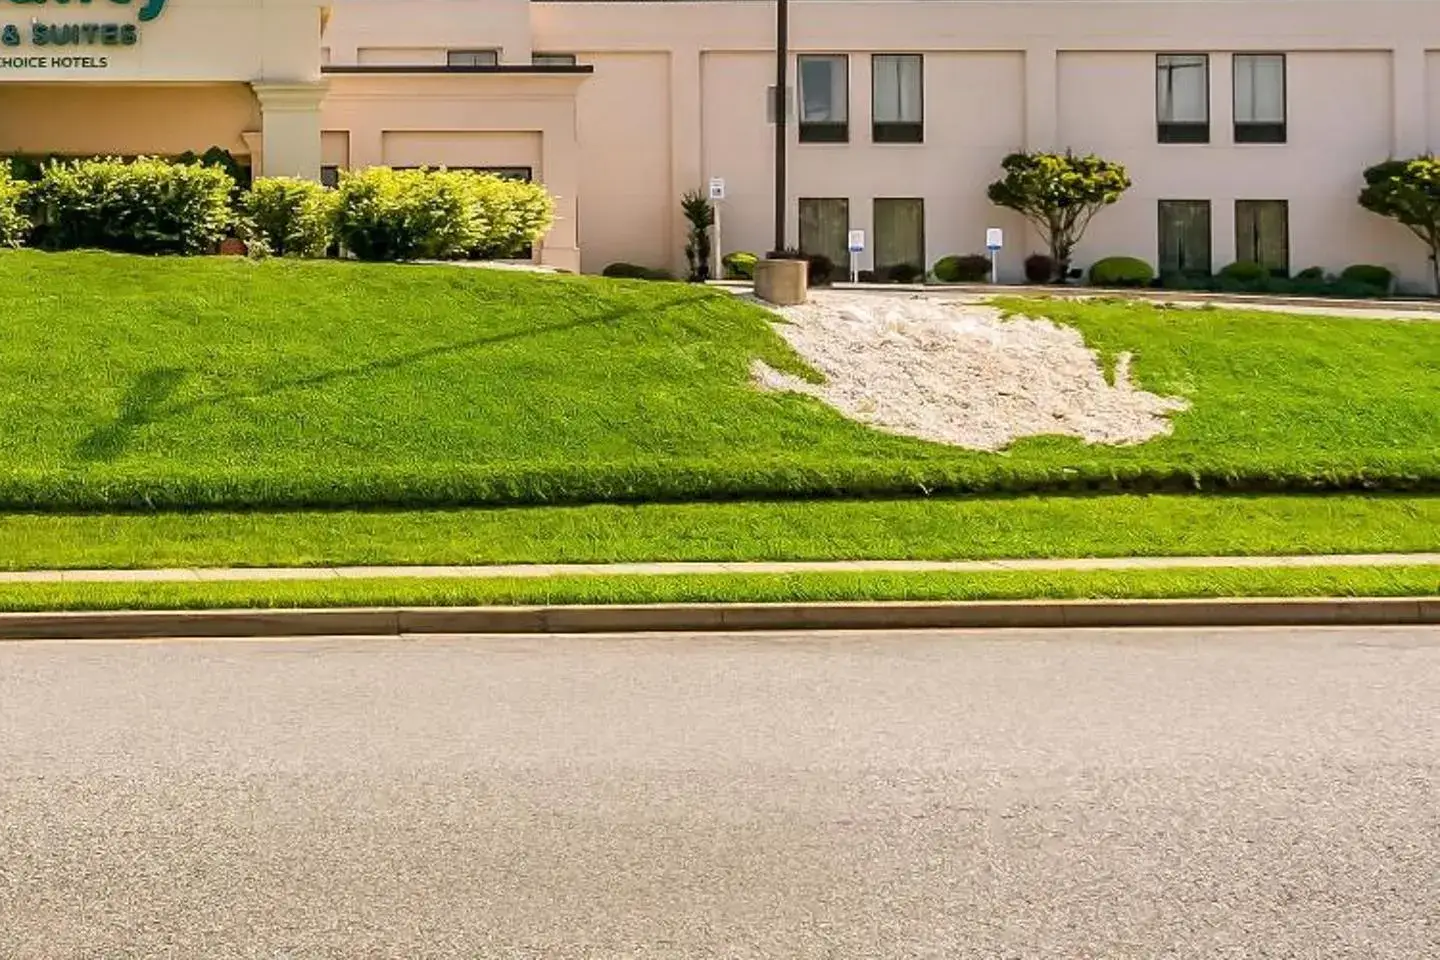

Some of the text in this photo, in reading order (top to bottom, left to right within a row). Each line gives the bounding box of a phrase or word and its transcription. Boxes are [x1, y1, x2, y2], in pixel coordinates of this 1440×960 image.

[2, 24, 21, 46] &
[32, 23, 137, 46] SUITES
[51, 56, 108, 69] HOTELS
